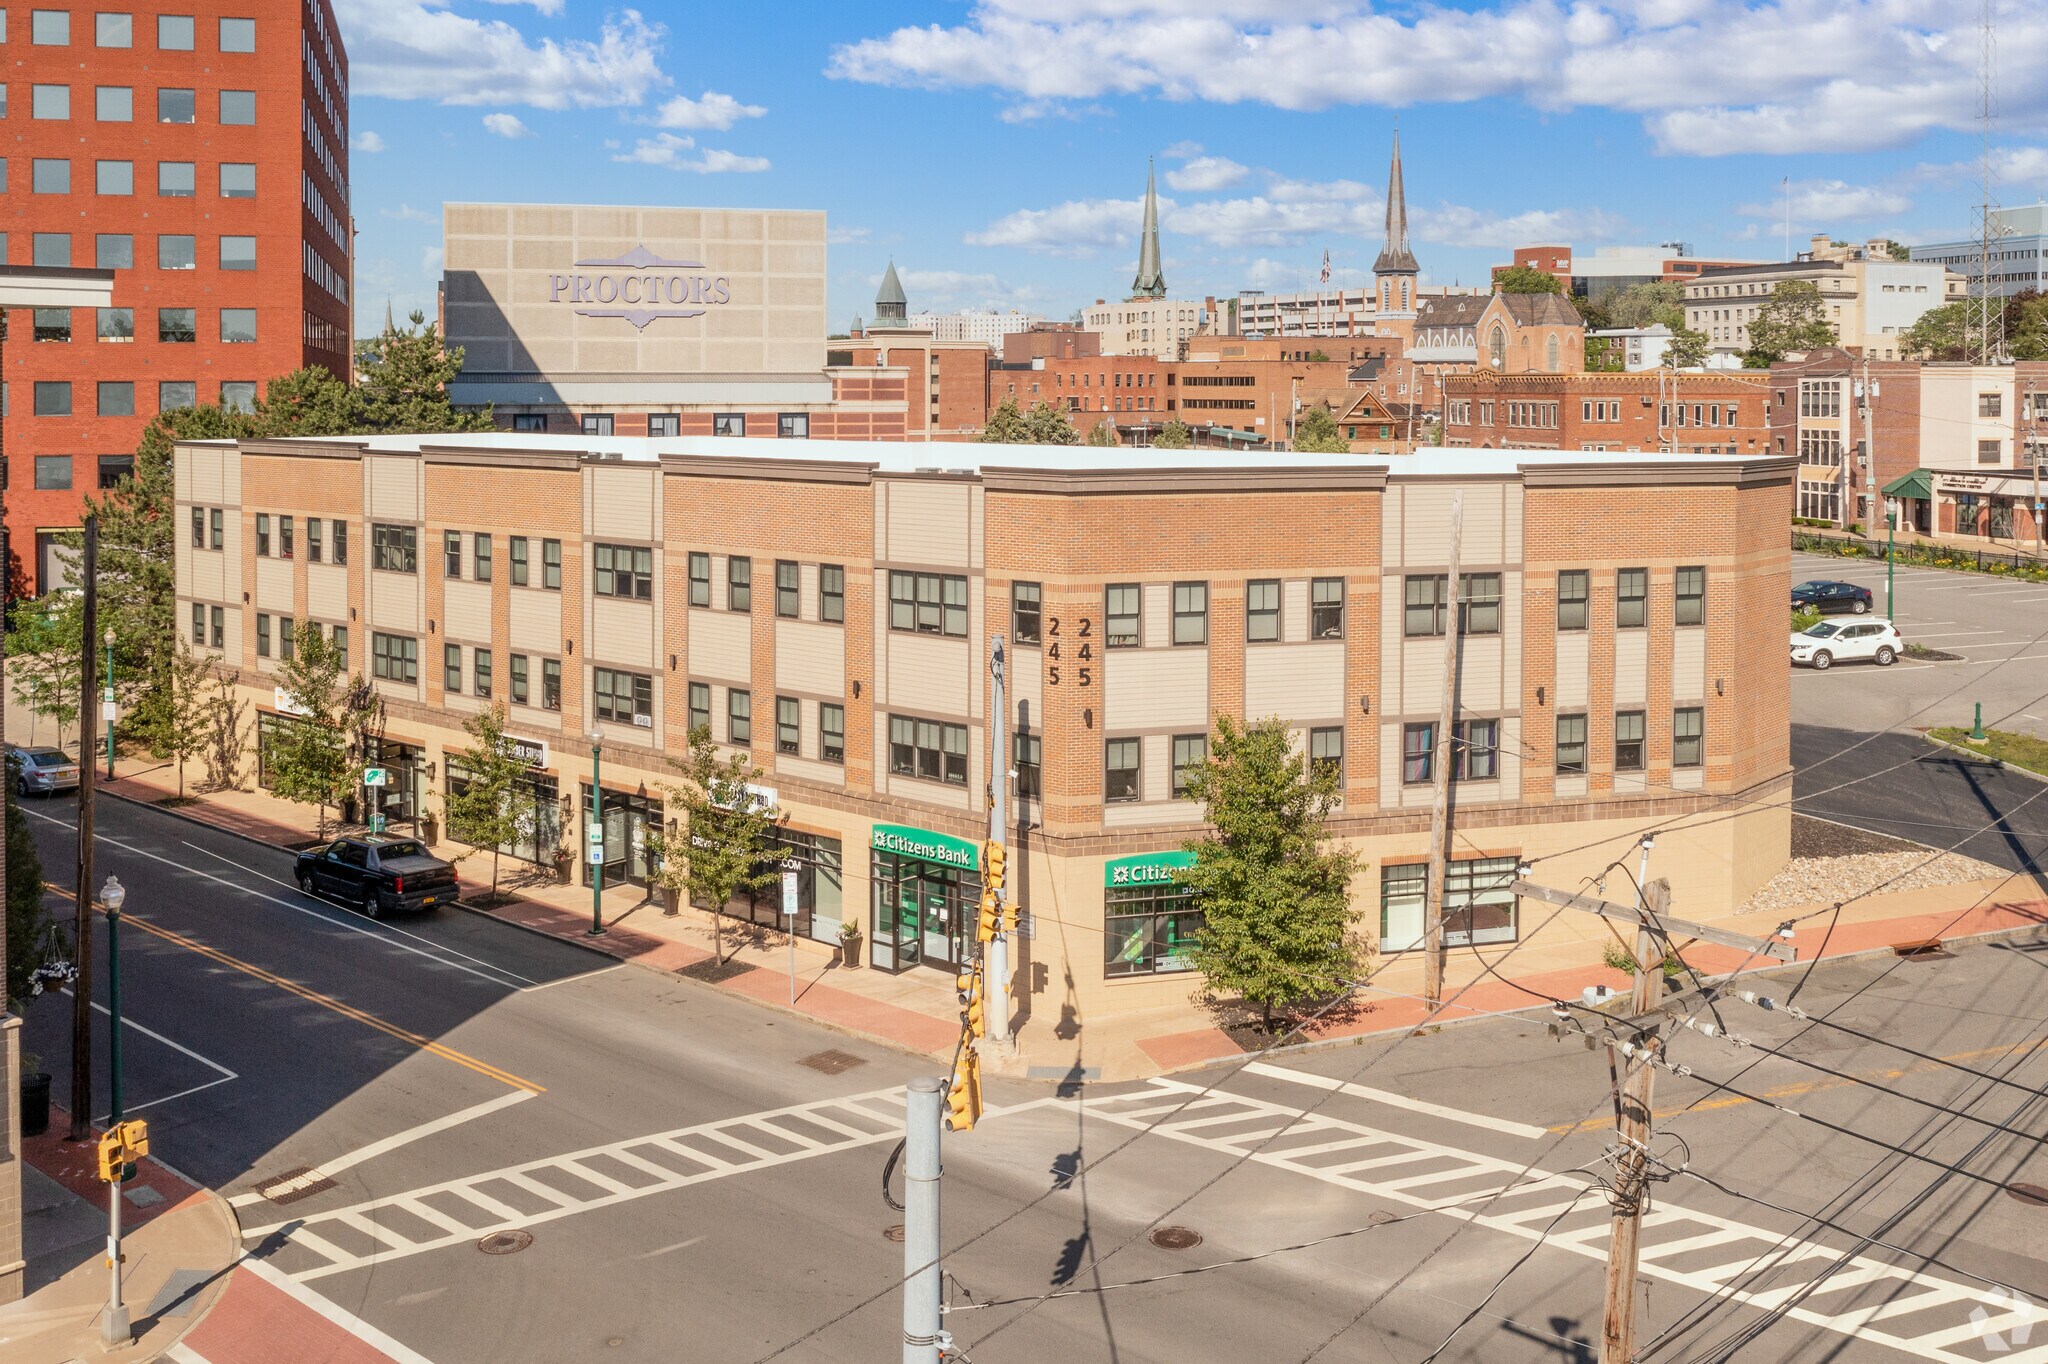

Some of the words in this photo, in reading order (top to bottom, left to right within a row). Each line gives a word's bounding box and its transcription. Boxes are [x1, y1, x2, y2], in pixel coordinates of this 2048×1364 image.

[549, 274, 731, 304] PROCTORS
[1048, 617, 1060, 685] 245
[1078, 618, 1092, 686] 245
[887, 834, 936, 858] Citizens
[937, 845, 970, 865] Bank
